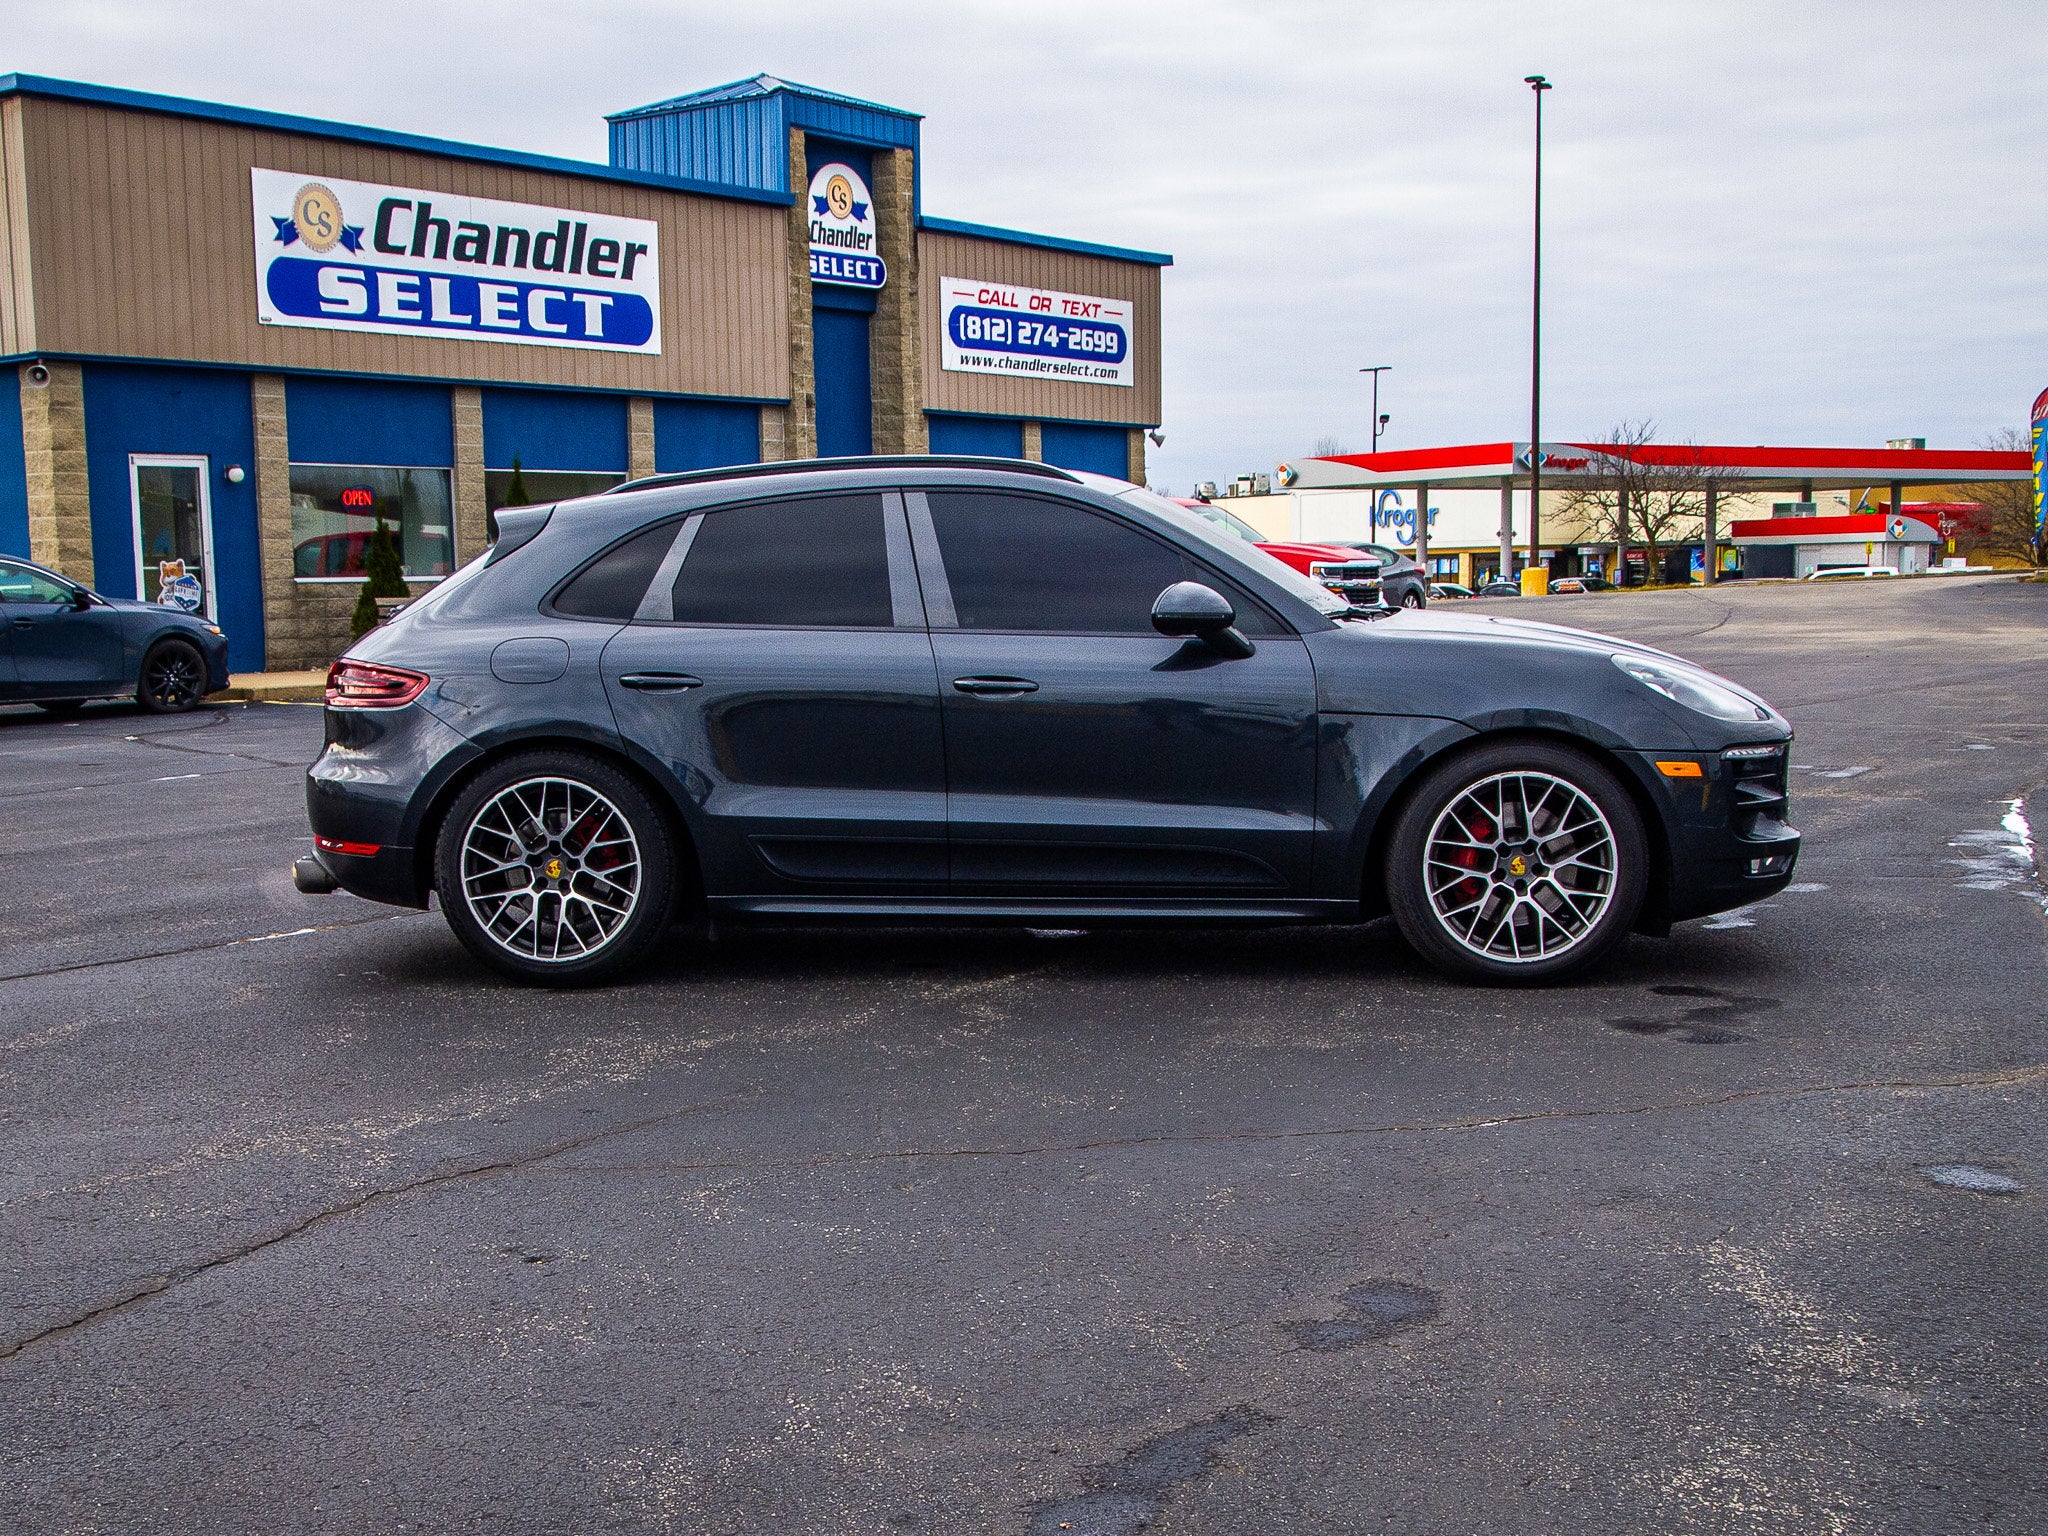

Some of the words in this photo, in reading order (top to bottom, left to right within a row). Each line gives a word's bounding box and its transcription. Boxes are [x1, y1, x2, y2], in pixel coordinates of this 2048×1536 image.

[832, 185, 847, 210] CS
[303, 199, 332, 237] CS
[374, 197, 648, 281] Chandler
[810, 220, 872, 250] Chandler
[318, 266, 614, 337] SELECT
[978, 289, 1019, 308] CALL
[1029, 295, 1052, 312] OR
[1062, 300, 1102, 318] TEXT
[959, 313, 1012, 345] (812)
[1018, 321, 1118, 354] 274-2699
[960, 354, 1118, 379] www.chandlerselect.com
[1546, 454, 1590, 471] Kroger
[342, 489, 372, 506] OPEN
[1369, 488, 1438, 546] Krogr
